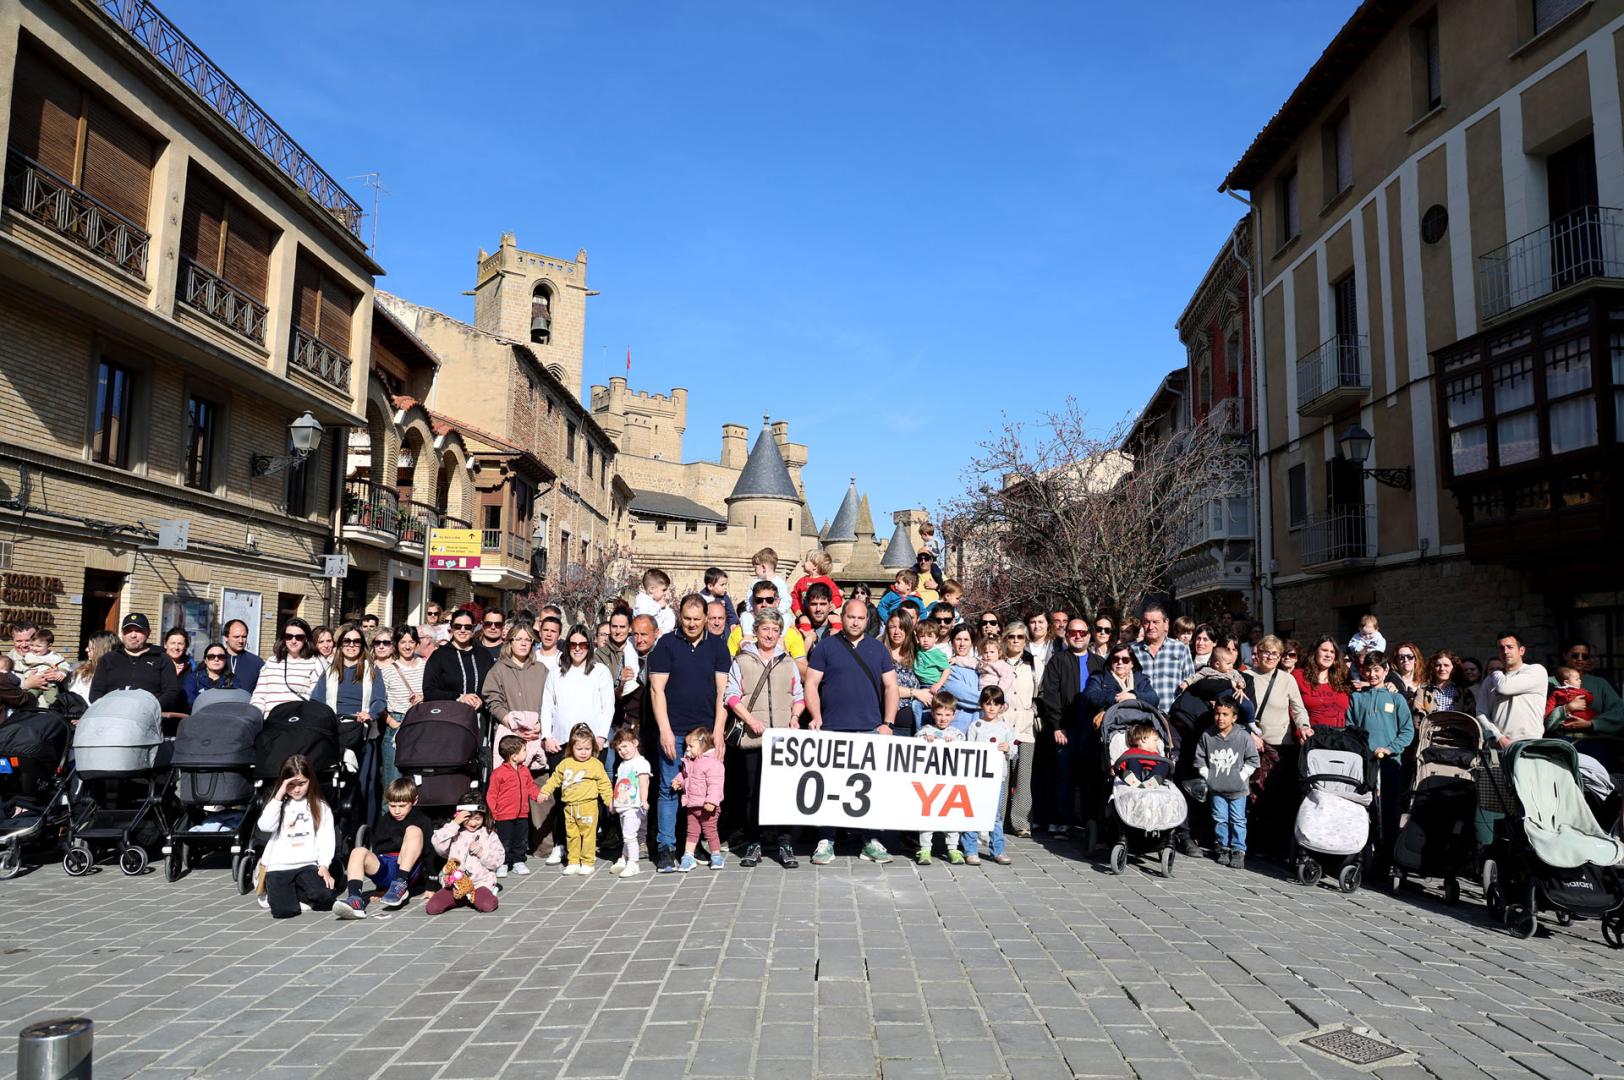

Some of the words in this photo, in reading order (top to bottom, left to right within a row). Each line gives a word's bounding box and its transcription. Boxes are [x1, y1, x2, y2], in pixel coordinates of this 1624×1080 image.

[770, 736, 876, 770] ESCUELA
[886, 743, 994, 778] INFANTIL
[796, 770, 872, 818] 0-3
[911, 781, 974, 818] YA
